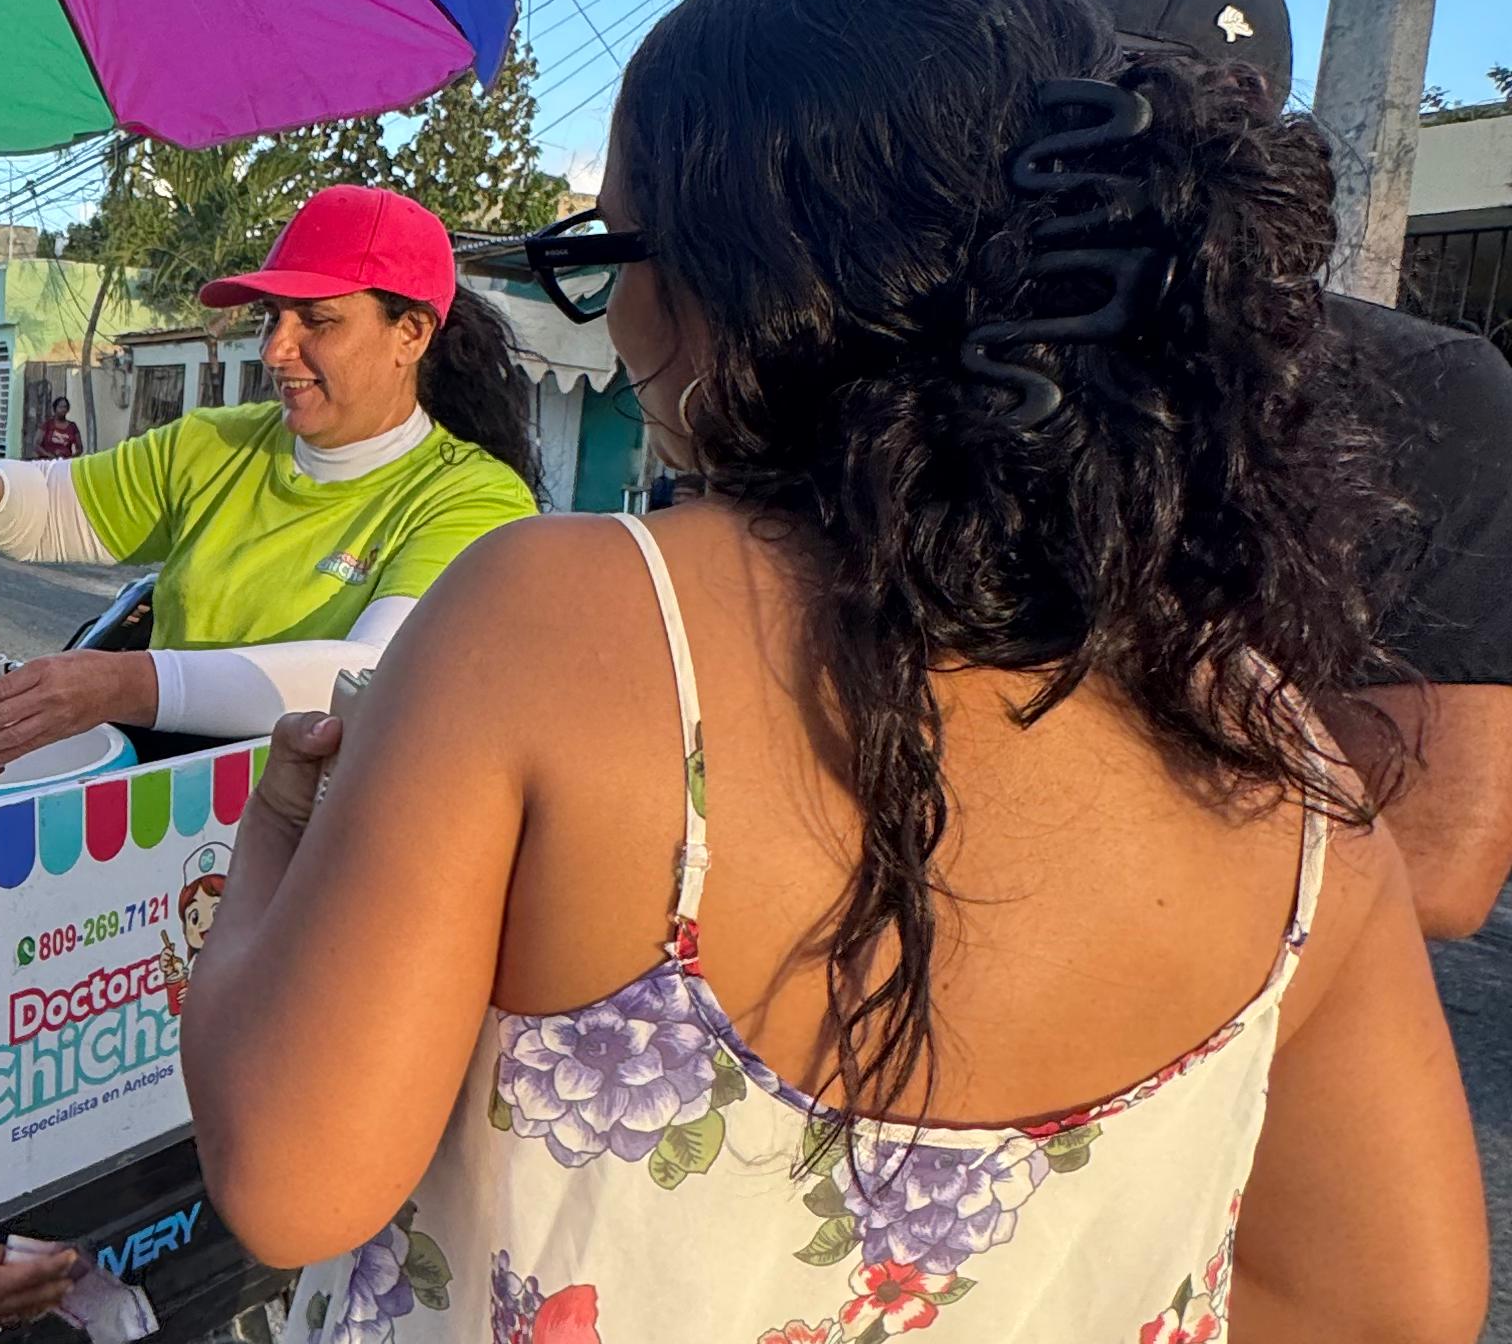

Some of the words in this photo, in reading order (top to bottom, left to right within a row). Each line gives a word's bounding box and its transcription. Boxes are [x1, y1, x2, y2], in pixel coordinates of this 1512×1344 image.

[39, 893, 169, 960] 809-269.7121
[9, 954, 167, 1046] Doctora
[11, 1100, 98, 1142] Especialista
[101, 1088, 120, 1103] en
[122, 1064, 174, 1095] Antojos
